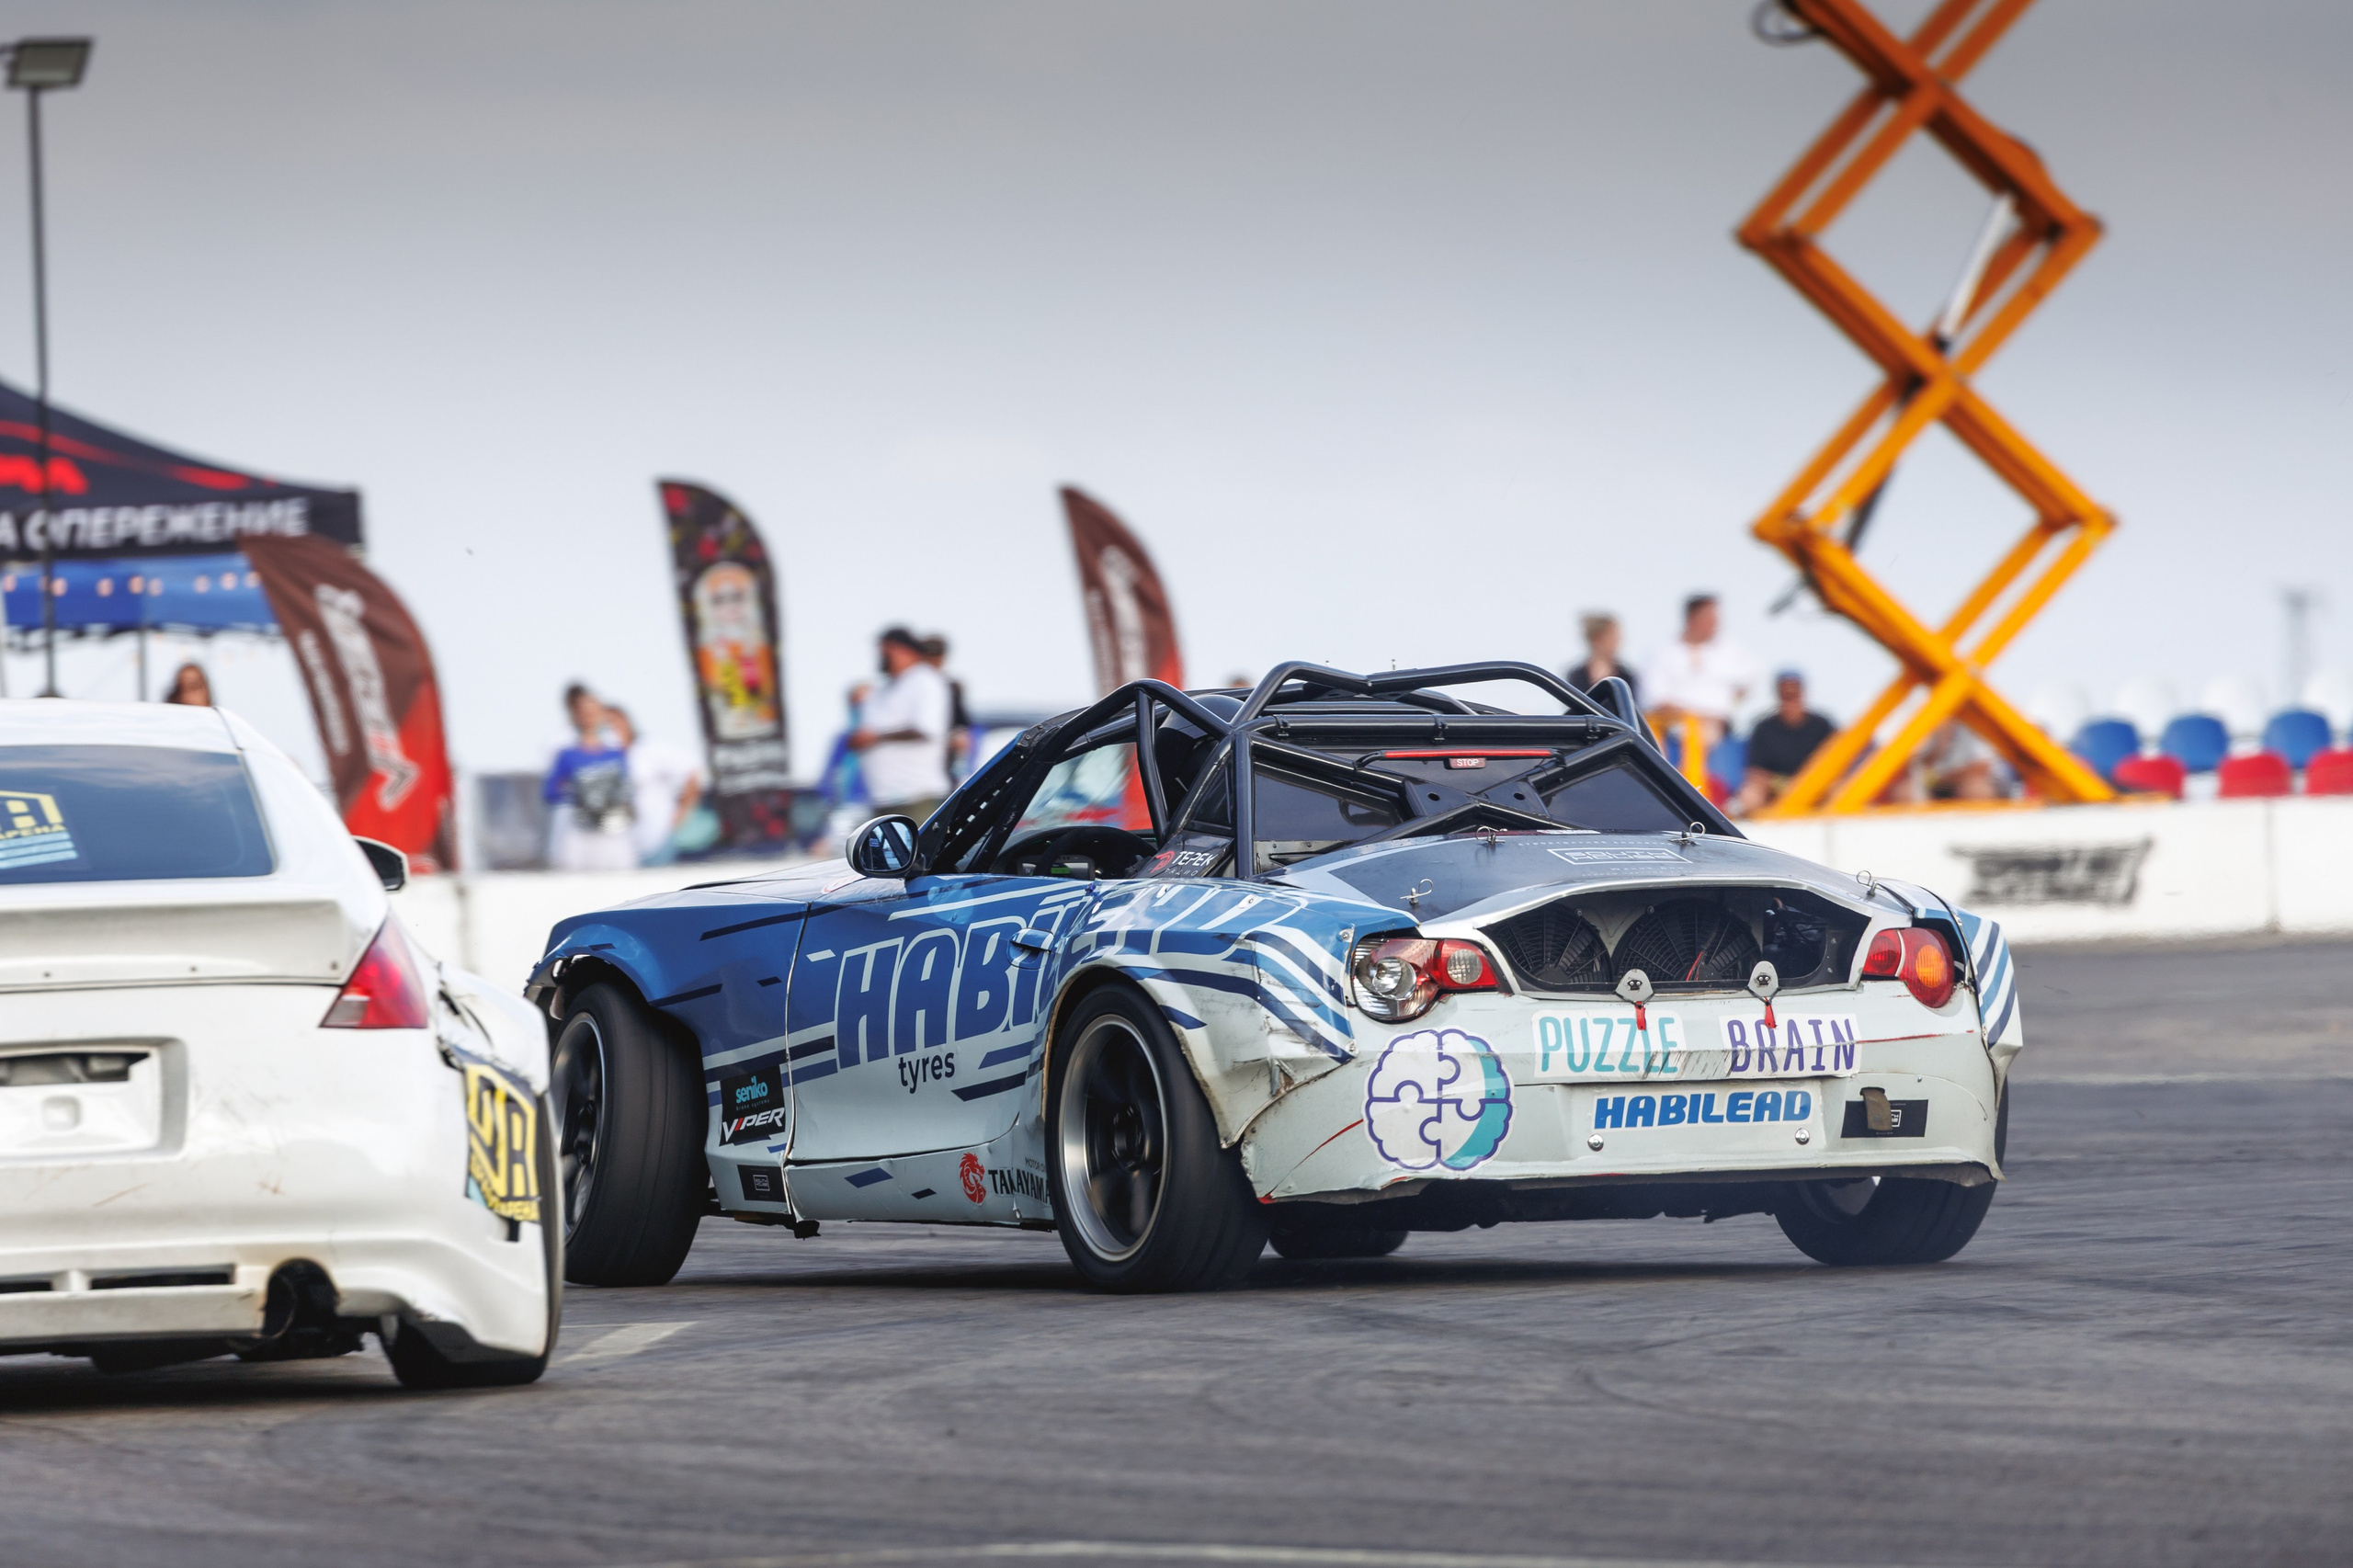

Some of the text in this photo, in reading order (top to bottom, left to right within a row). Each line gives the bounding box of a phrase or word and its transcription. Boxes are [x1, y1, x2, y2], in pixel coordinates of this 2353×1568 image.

[1456, 758, 1480, 767] STOP
[1172, 851, 1218, 866] ТЕРЕК
[1538, 1016, 1857, 1074] PUZZLE BRAIN
[735, 1075, 768, 1104] seniko
[898, 1051, 955, 1094] tyres
[722, 1108, 785, 1142] VIPER
[1594, 1090, 1812, 1130] HABILEAD
